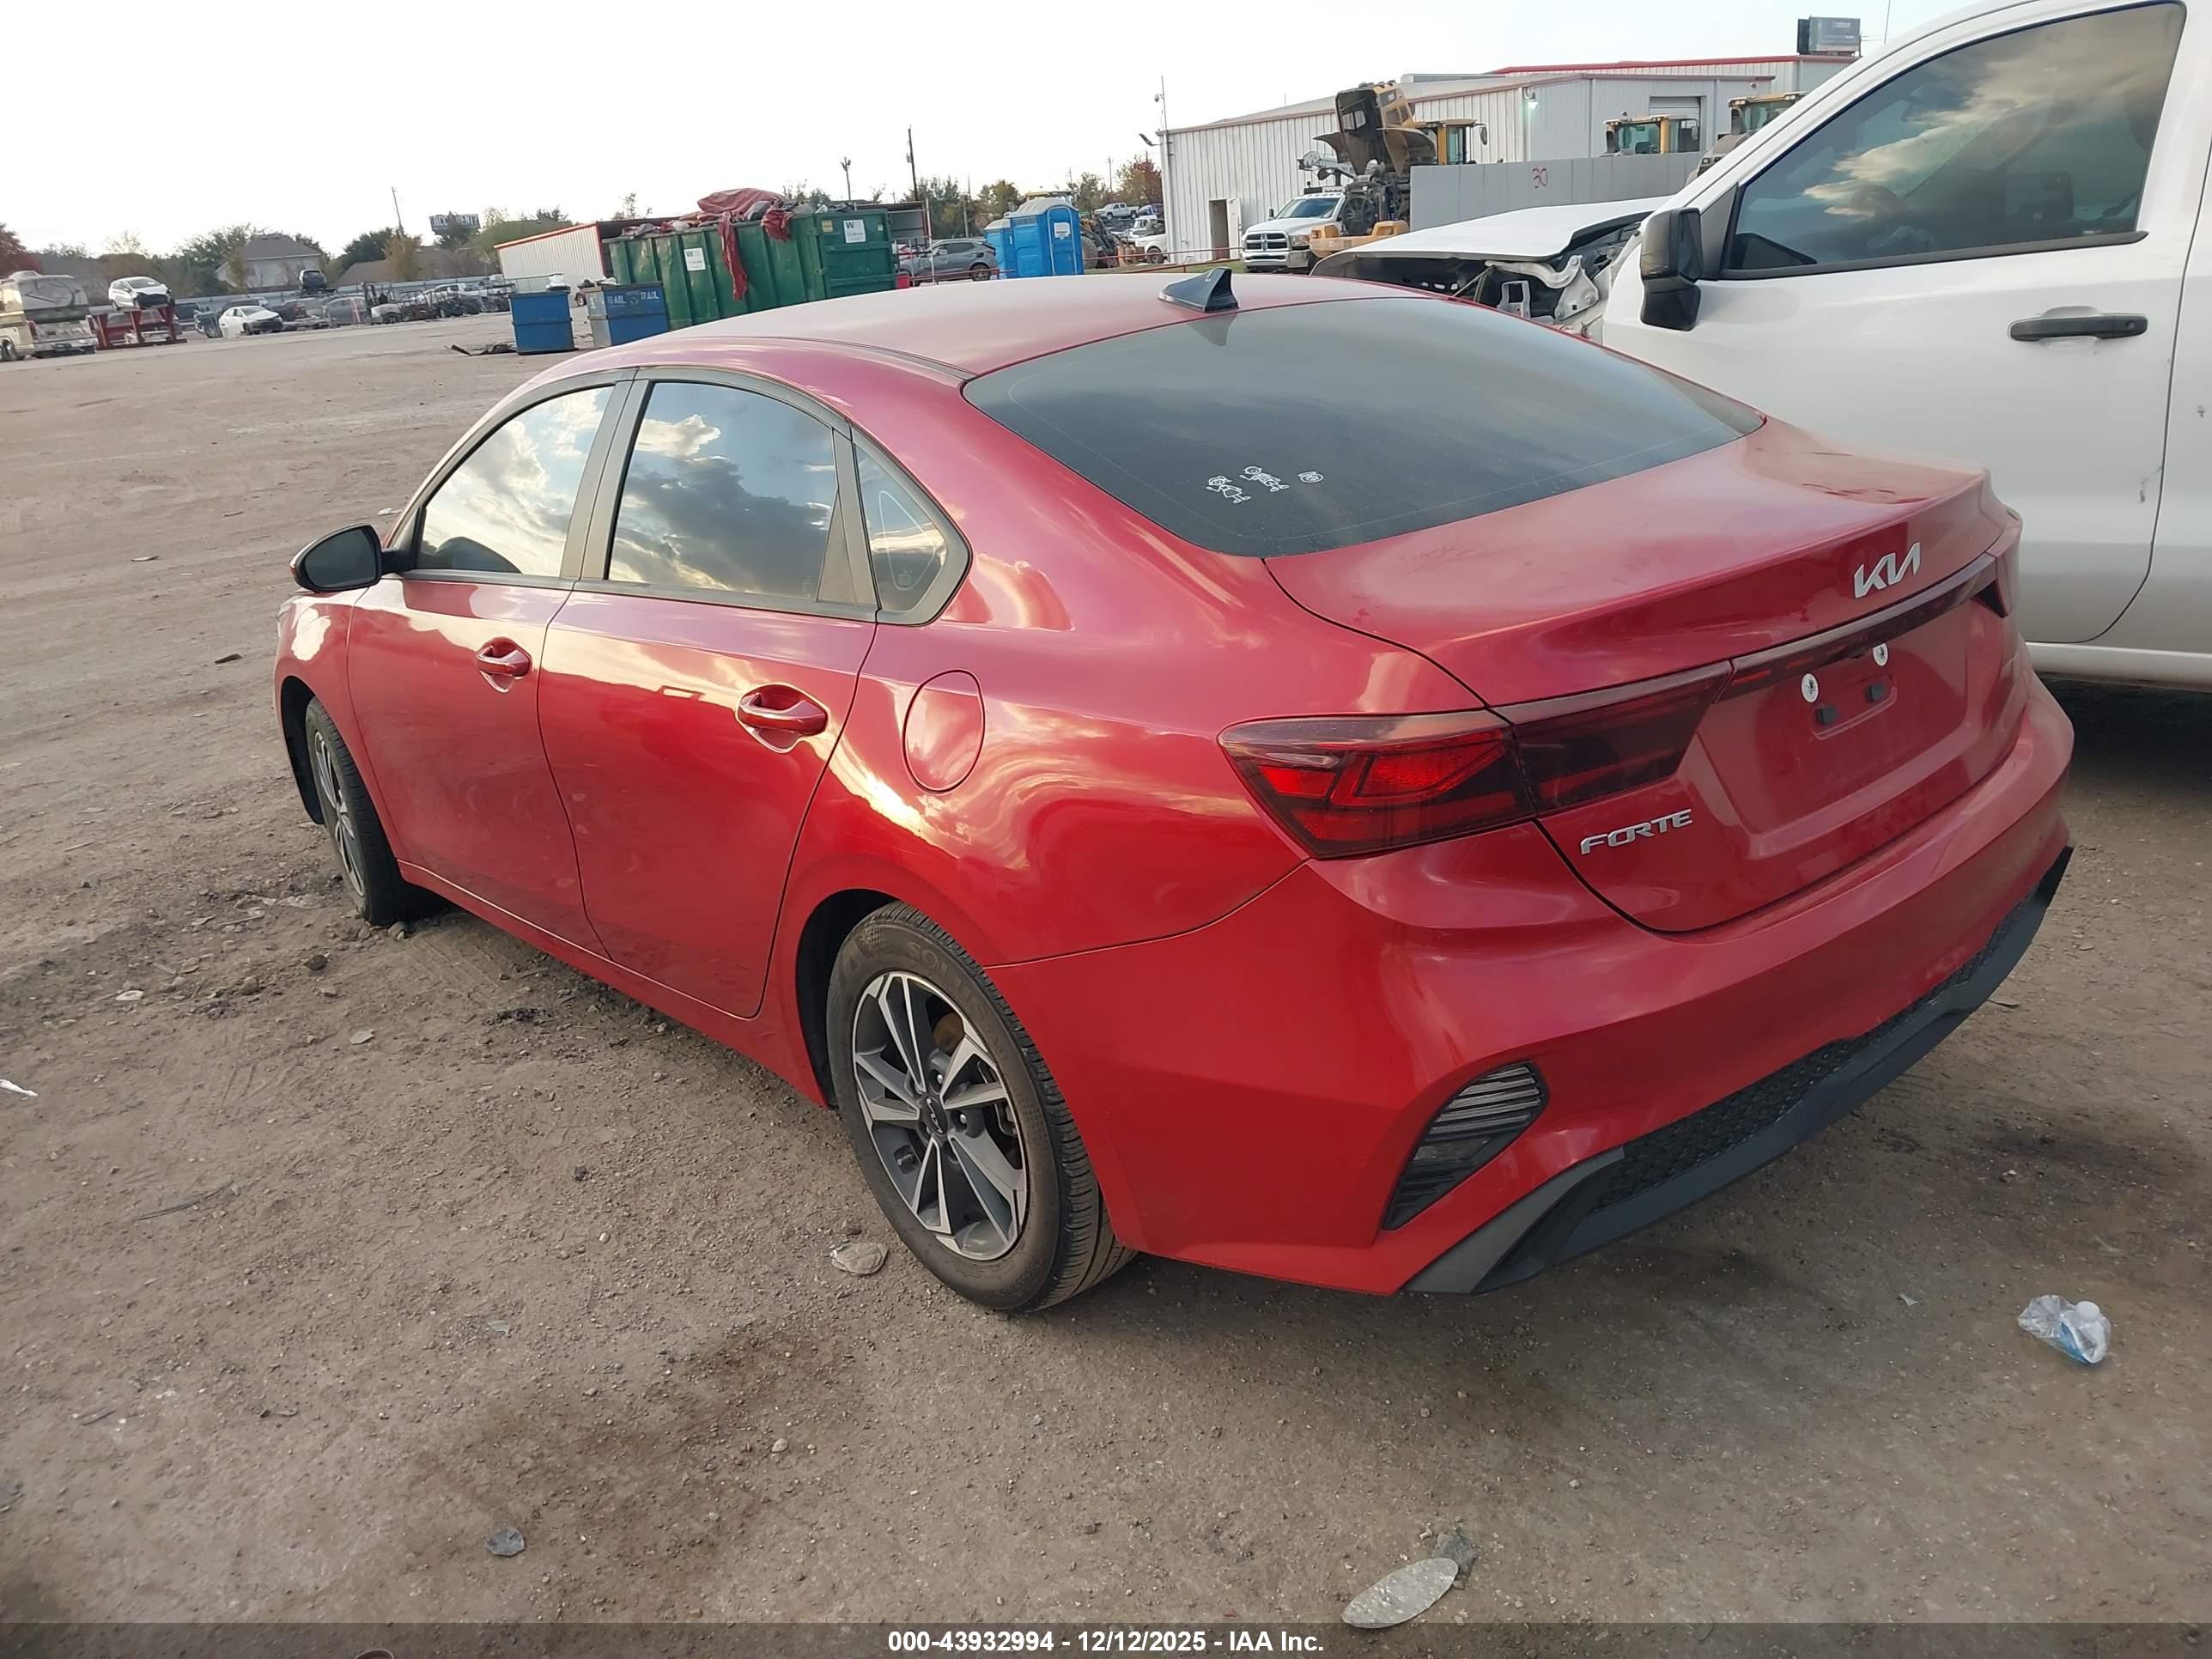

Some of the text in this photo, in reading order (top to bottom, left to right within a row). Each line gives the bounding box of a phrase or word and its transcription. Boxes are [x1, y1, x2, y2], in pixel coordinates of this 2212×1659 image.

[1532, 167, 1548, 189] 30
[1854, 542, 1921, 599] KIA
[1580, 808, 1693, 855] FORTE
